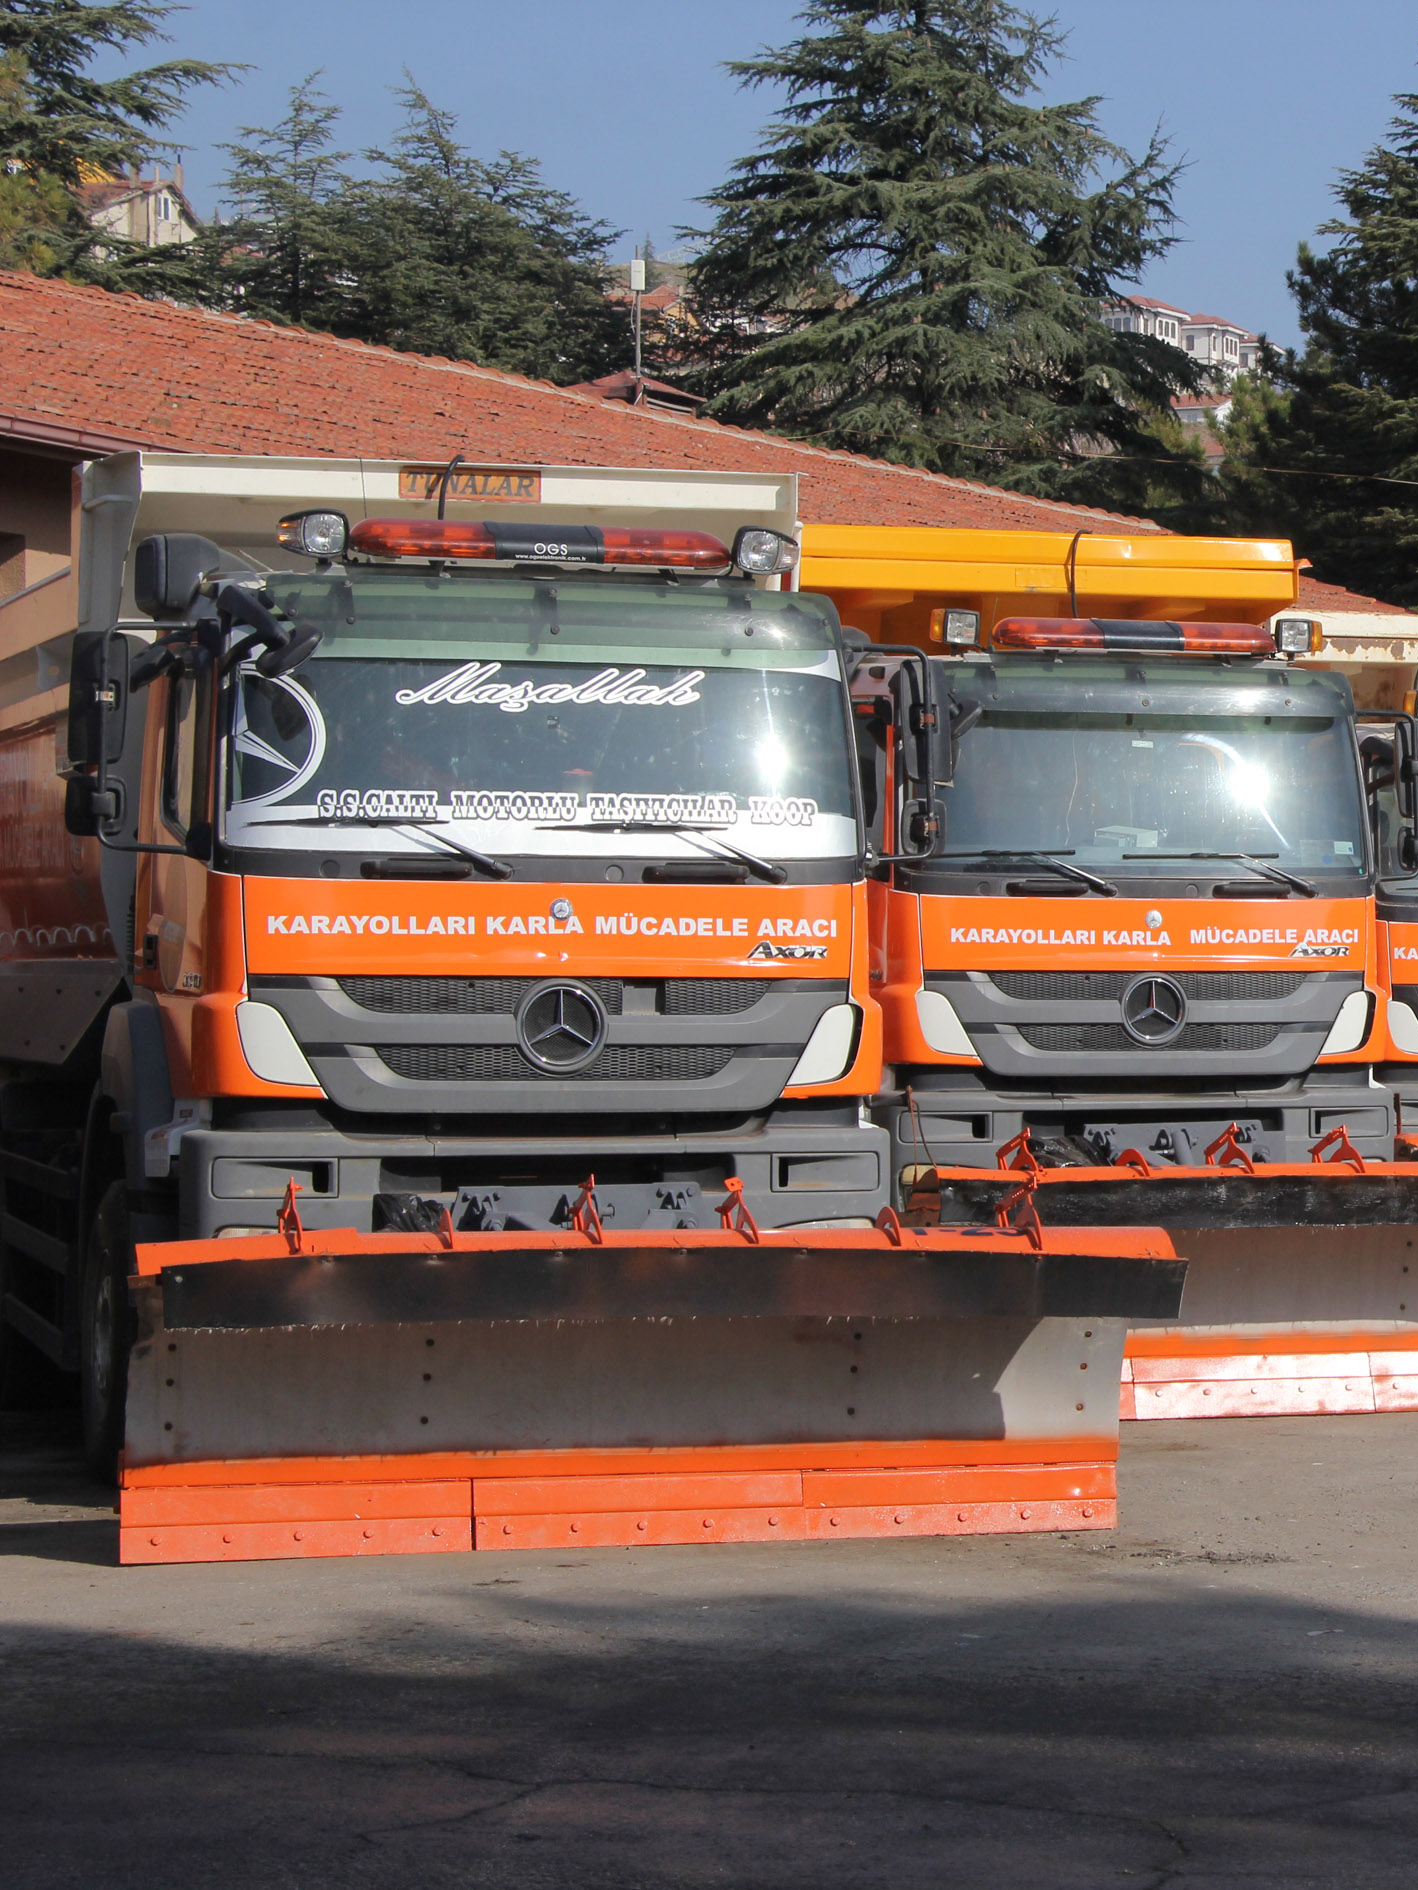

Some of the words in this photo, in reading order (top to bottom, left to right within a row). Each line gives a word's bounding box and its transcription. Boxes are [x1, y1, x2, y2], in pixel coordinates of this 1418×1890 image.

[406, 471, 535, 497] TUNALAR
[534, 543, 568, 555] OGS
[450, 790, 579, 822] MOTORLU
[749, 796, 818, 827] KOOP
[267, 915, 475, 934] KARAYOLLARI
[486, 916, 584, 934] KARLA
[595, 913, 749, 936] MÜCADELE
[757, 918, 837, 937] ARACI
[950, 928, 1096, 945] KARAYOLLARI
[1102, 930, 1172, 945] KARLA
[1190, 926, 1298, 944] MÜCADELE
[1303, 928, 1359, 943] ARACI
